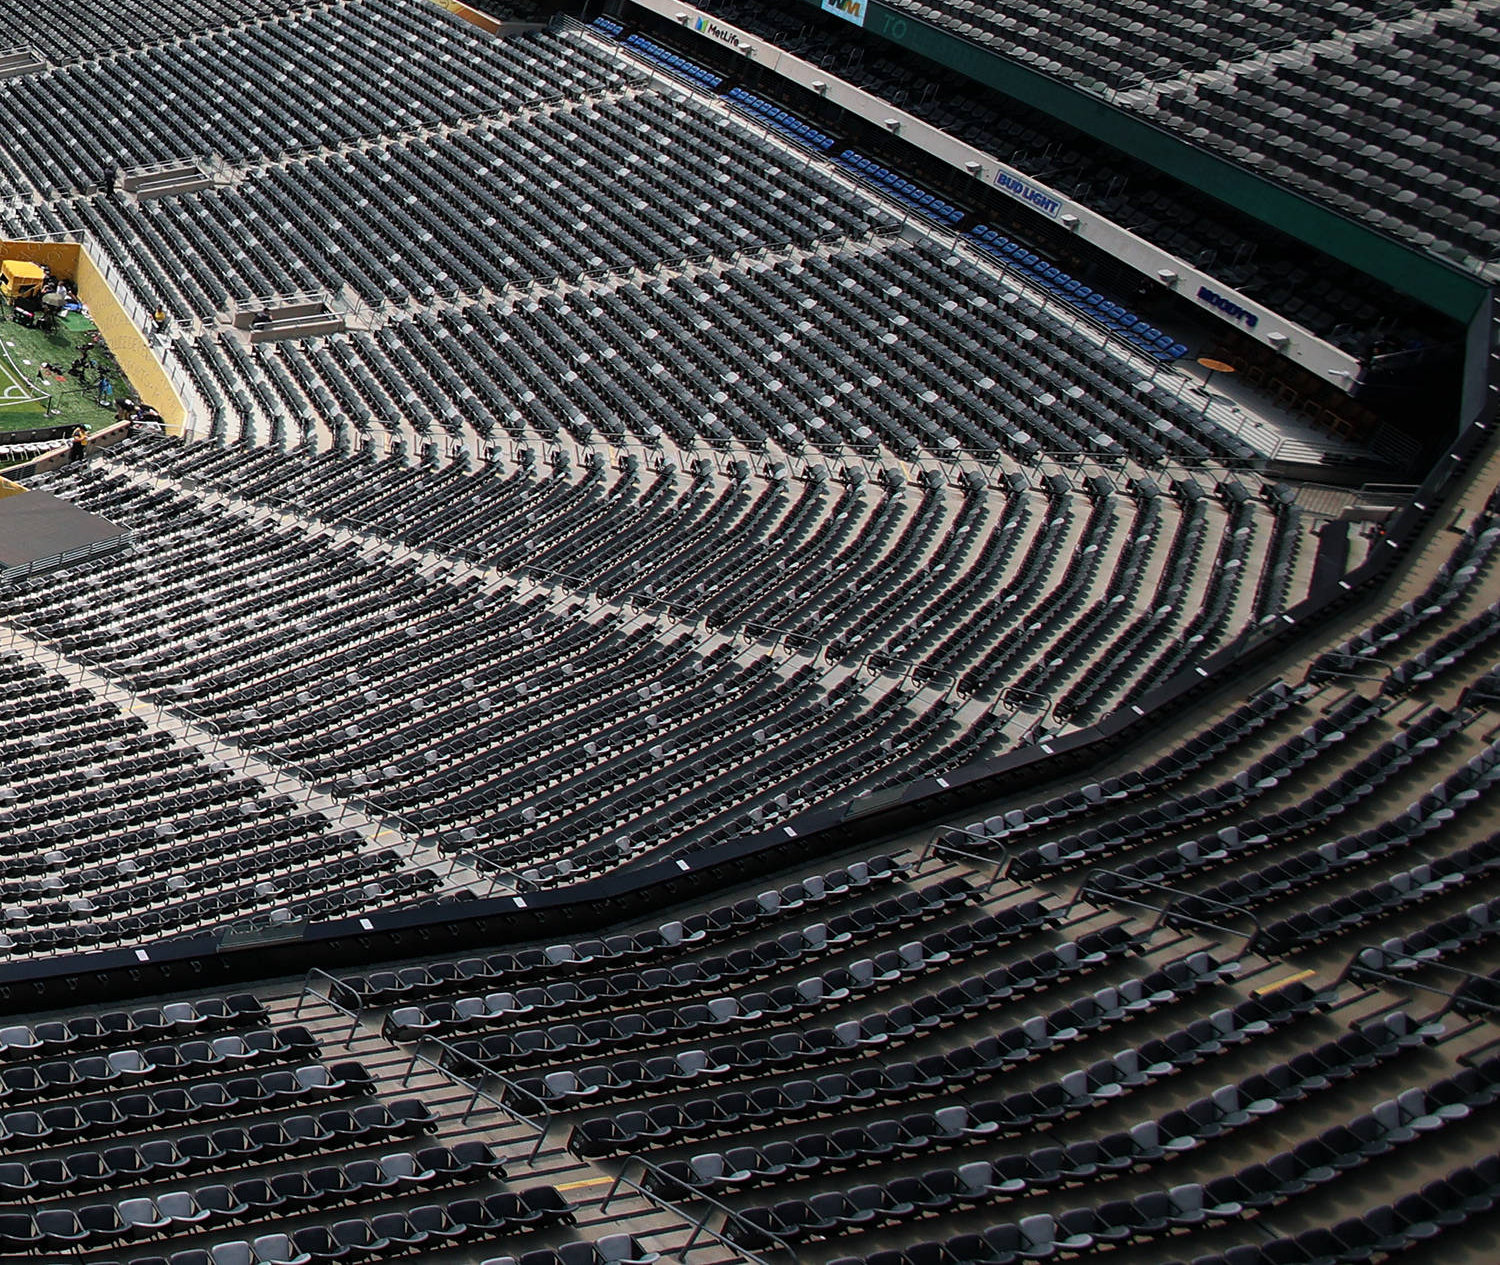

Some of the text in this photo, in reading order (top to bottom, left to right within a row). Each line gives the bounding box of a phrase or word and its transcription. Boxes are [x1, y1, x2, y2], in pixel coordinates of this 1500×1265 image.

[708, 23, 740, 47] MetLife
[997, 171, 1059, 214] BUD LIGHT
